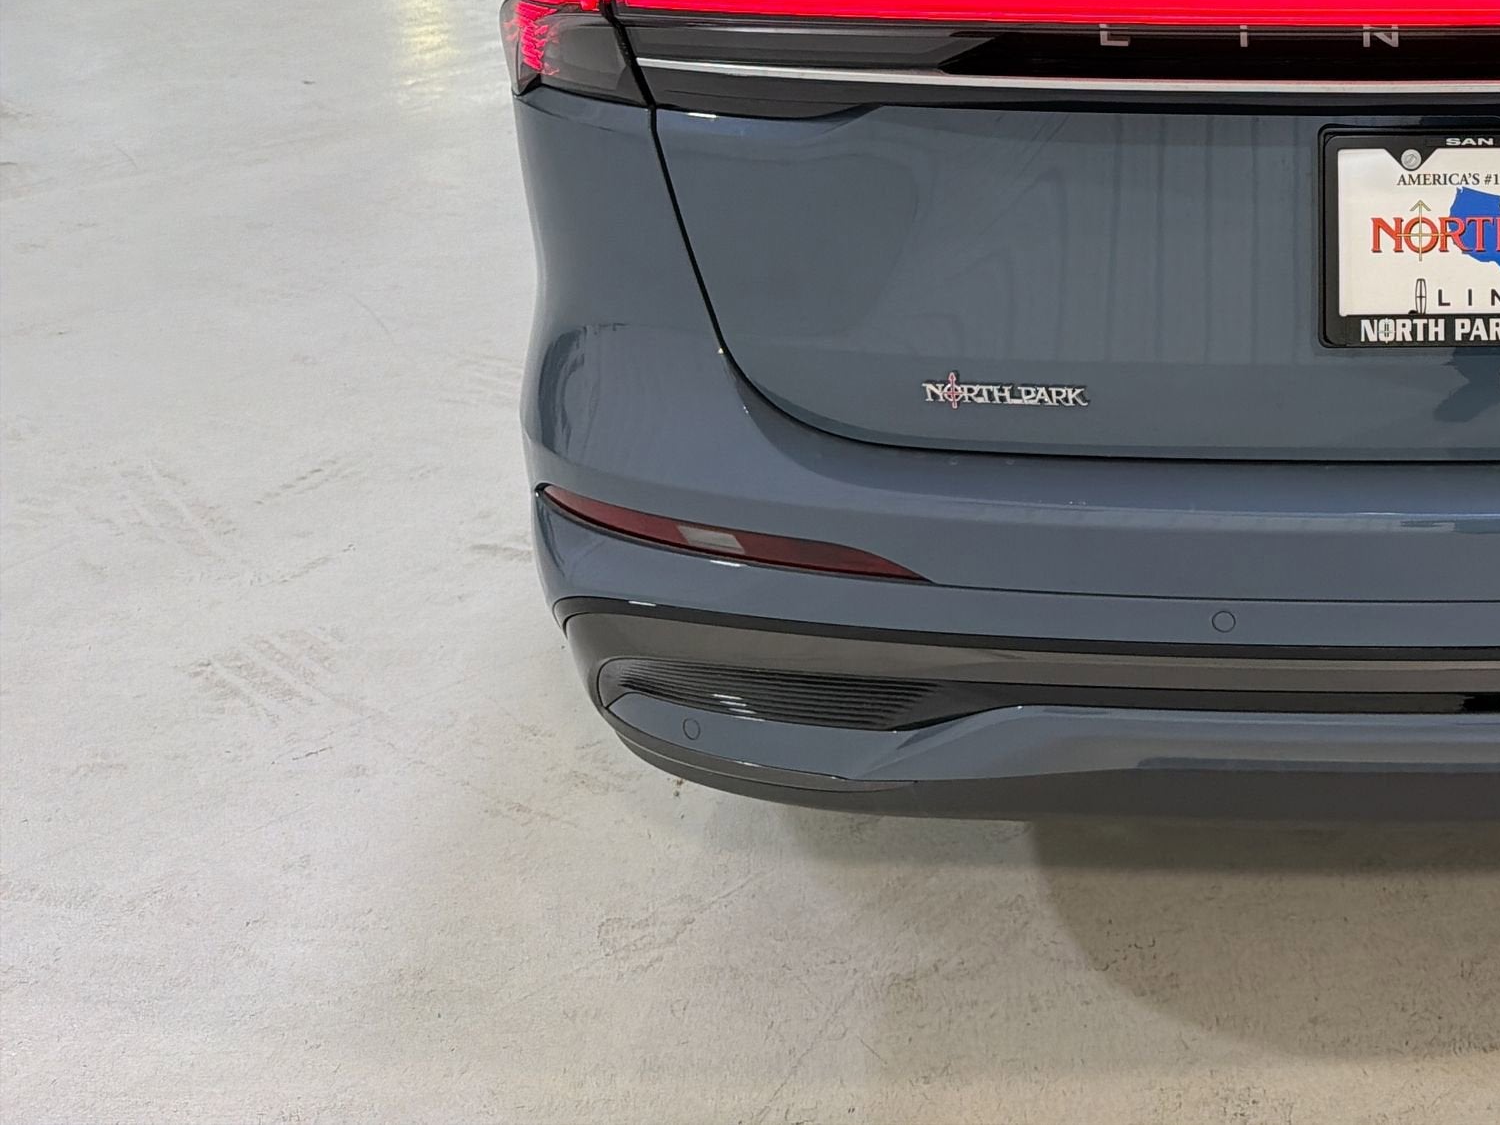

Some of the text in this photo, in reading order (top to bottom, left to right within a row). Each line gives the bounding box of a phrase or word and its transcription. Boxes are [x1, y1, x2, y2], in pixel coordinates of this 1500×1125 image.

[1446, 137, 1494, 146] SAN
[1397, 172, 1480, 186] AMERICA'S
[1484, 172, 1499, 186] #1
[1361, 318, 1446, 343] NORTH
[922, 383, 1088, 407] NORTH PARK
